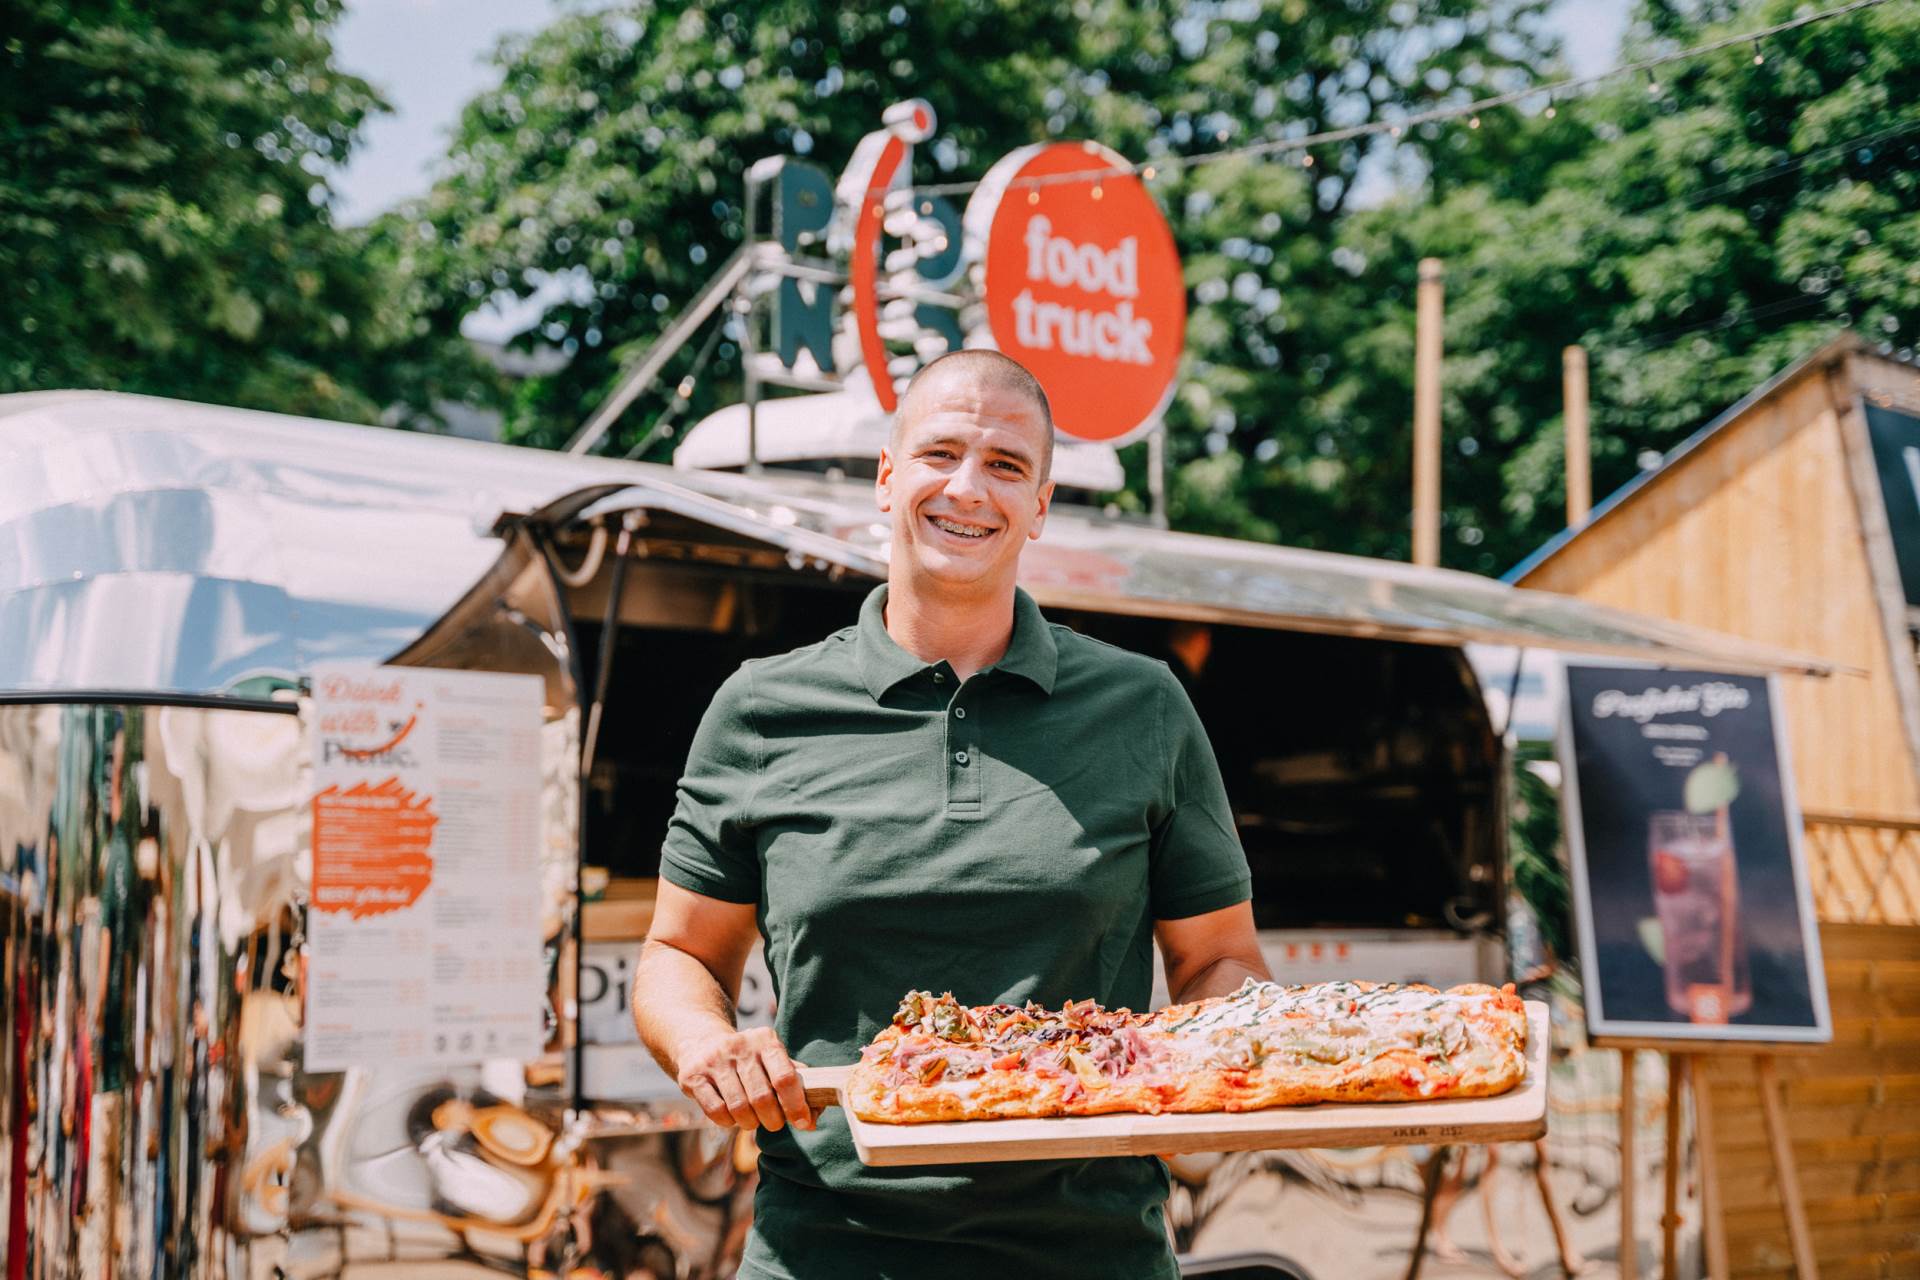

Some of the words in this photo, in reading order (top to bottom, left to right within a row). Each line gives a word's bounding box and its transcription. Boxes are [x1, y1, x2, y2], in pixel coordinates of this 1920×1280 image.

[1026, 215, 1139, 297] food
[1012, 289, 1154, 365] truck
[1393, 1126, 1428, 1137] IKEA
